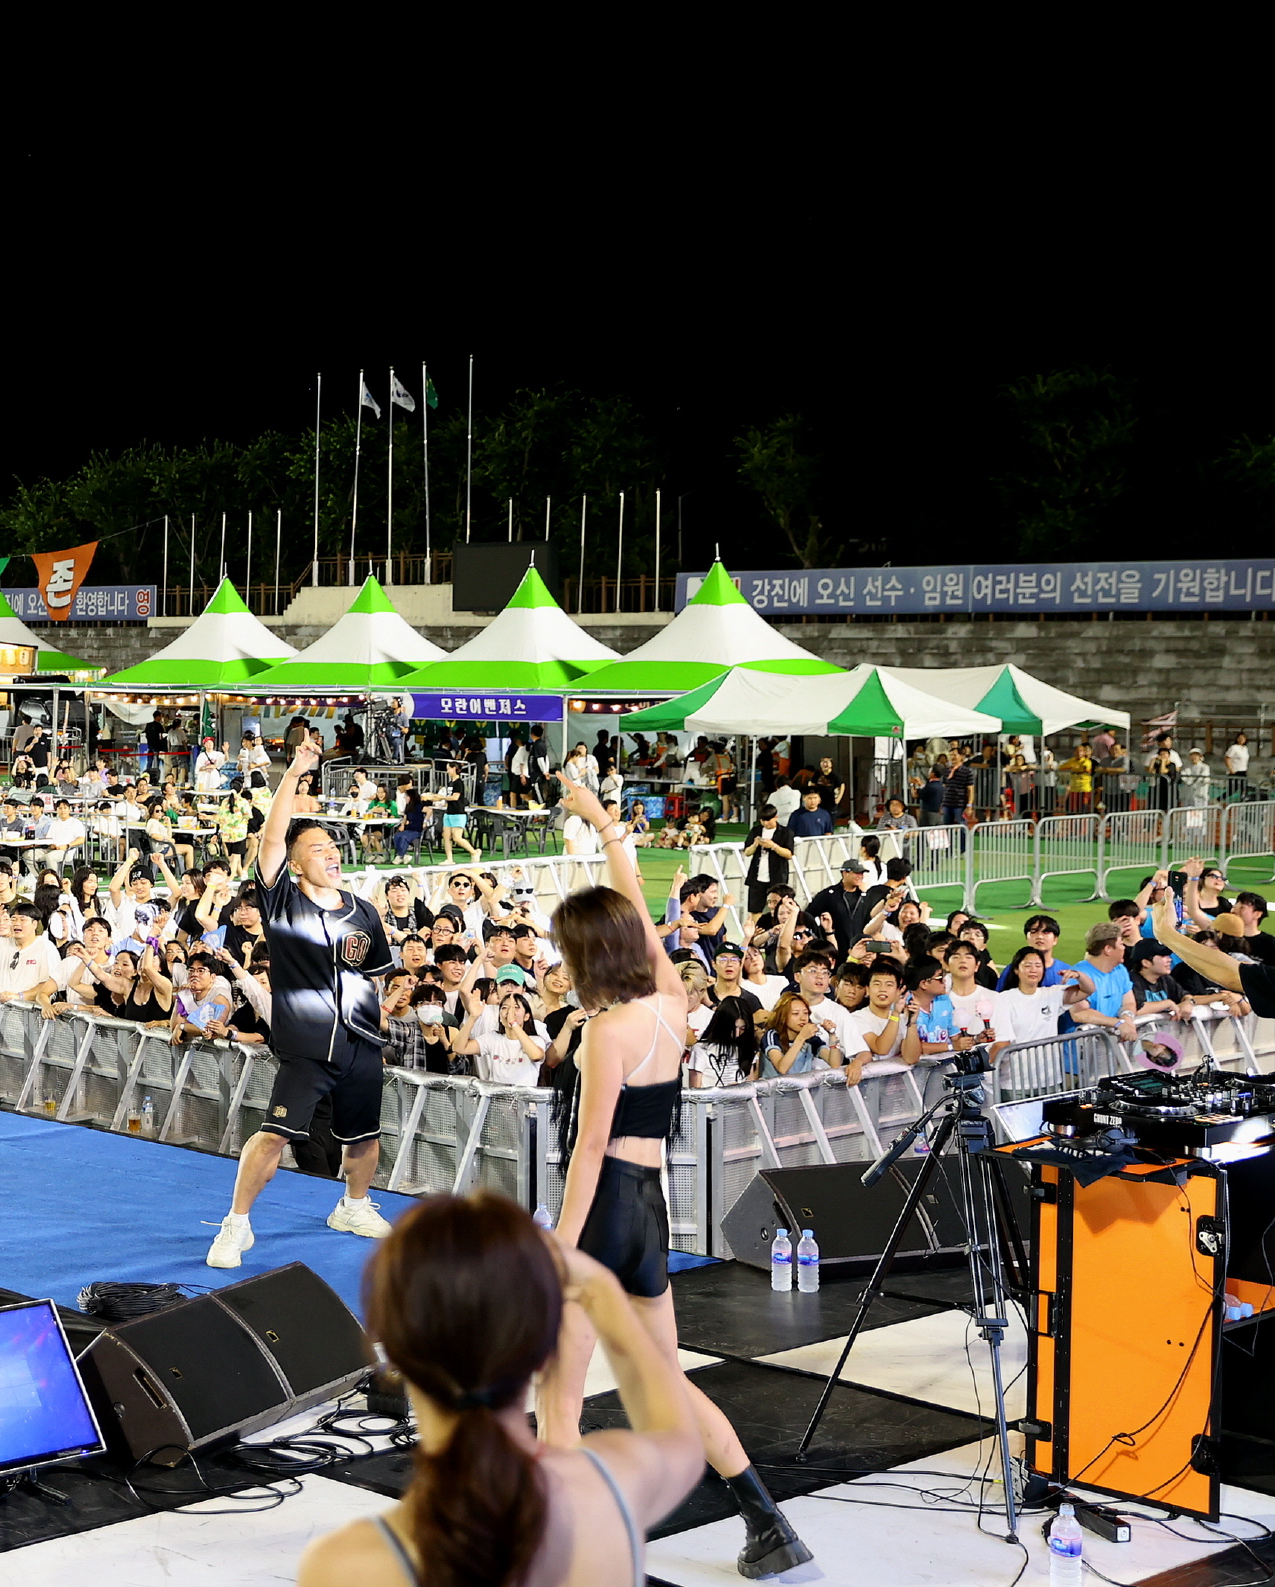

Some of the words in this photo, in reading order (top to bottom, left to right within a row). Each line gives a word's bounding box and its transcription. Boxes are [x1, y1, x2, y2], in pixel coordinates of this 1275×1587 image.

[45, 558, 75, 608] 존
[751, 575, 809, 609] 강진에
[815, 575, 856, 607] 오신
[862, 574, 905, 606] 선수
[922, 572, 965, 606] 임원
[973, 570, 1062, 605] 여러분의
[1070, 569, 1143, 604] 선전을
[1151, 567, 1275, 604] 기원합니다
[75, 590, 129, 616] 환영합니다
[440, 697, 527, 715] 모란어벤져스
